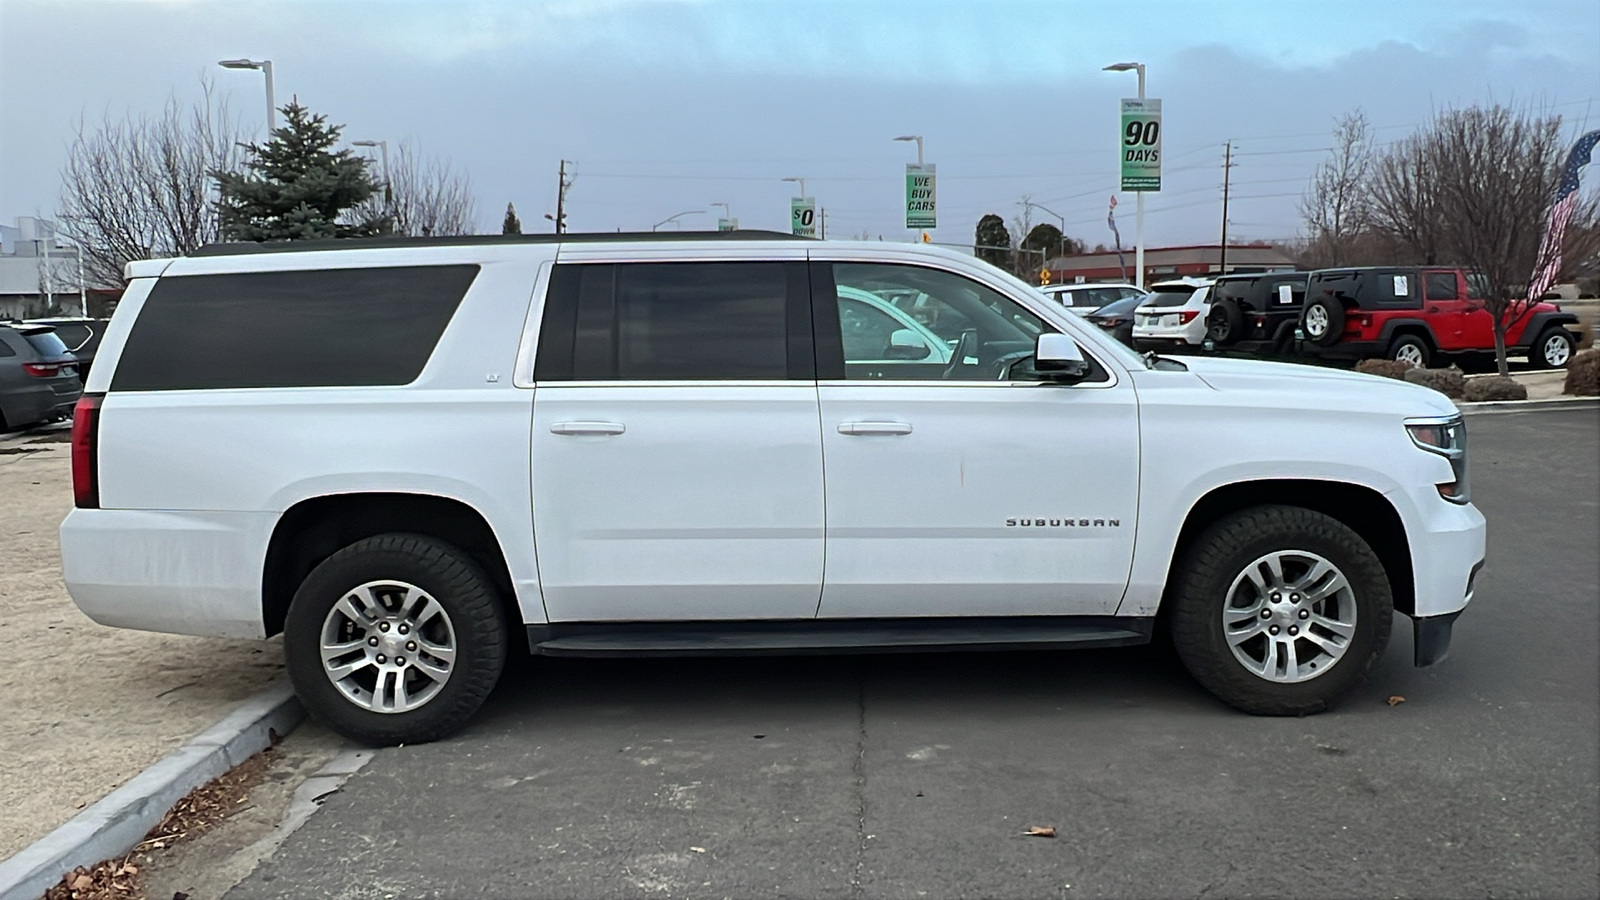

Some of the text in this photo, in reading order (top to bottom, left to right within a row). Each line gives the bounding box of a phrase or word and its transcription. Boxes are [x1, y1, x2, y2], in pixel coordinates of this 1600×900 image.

[1124, 121, 1159, 146] 90
[1125, 150, 1159, 162] DAYS
[914, 177, 930, 187] WE
[911, 189, 932, 199] BUY
[908, 201, 935, 211] CARS
[793, 209, 814, 226] $0
[1006, 518, 1120, 527] SUBURBAN
